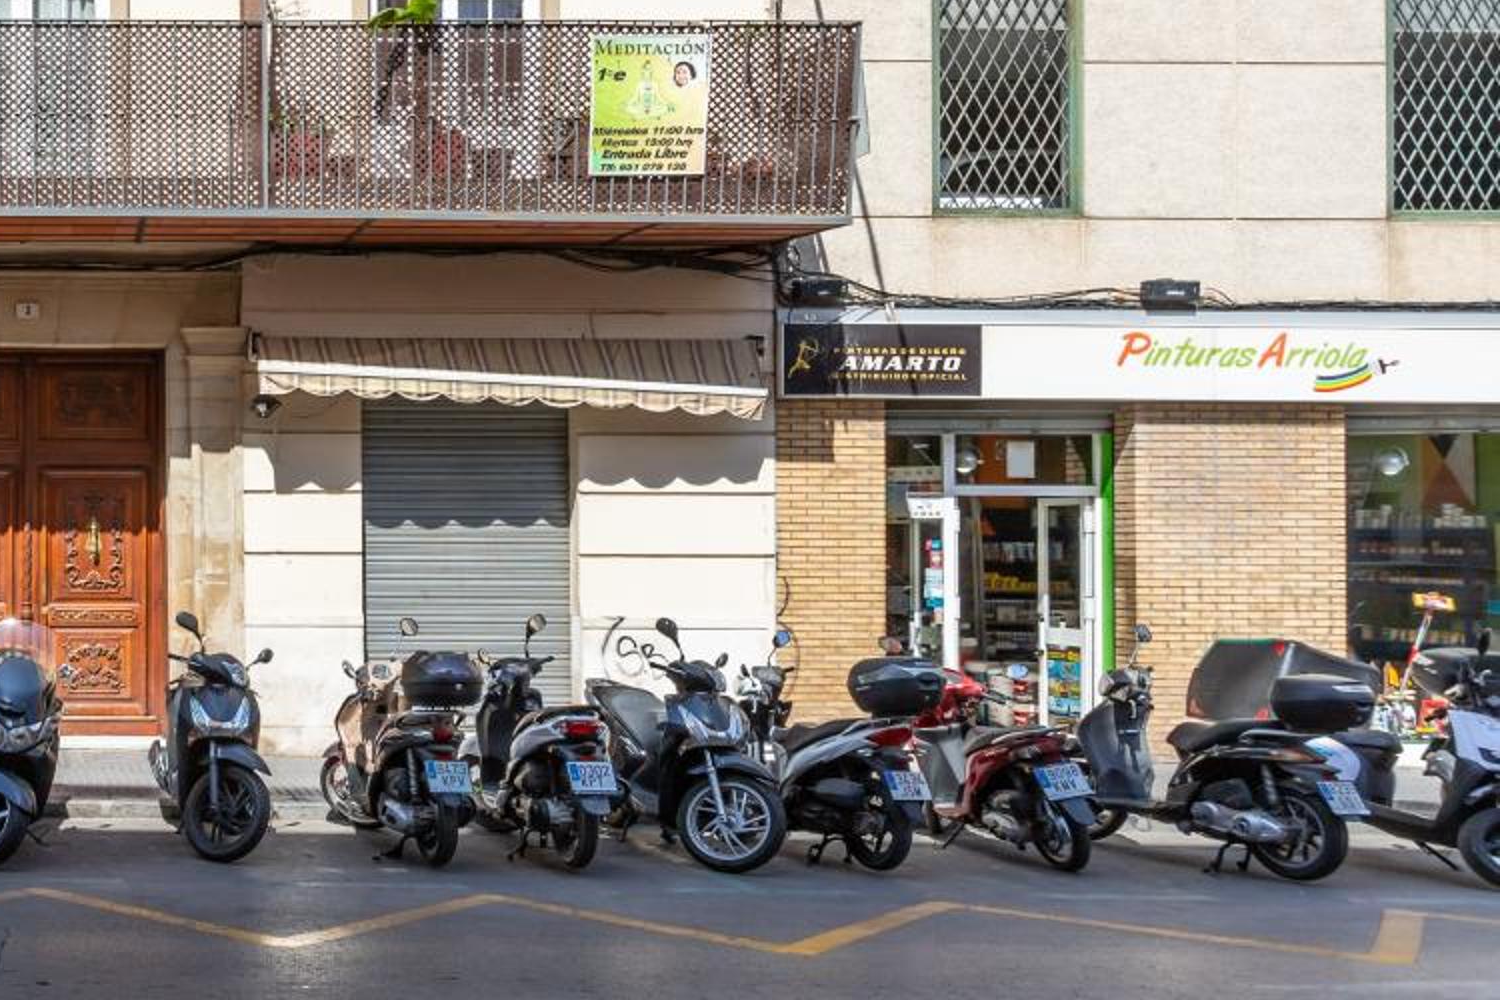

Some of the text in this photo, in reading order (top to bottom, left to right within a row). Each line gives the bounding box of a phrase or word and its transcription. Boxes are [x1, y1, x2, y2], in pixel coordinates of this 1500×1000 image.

[602, 149, 688, 159] Entrada Libre
[1116, 332, 1369, 369] Pinturas Arriola
